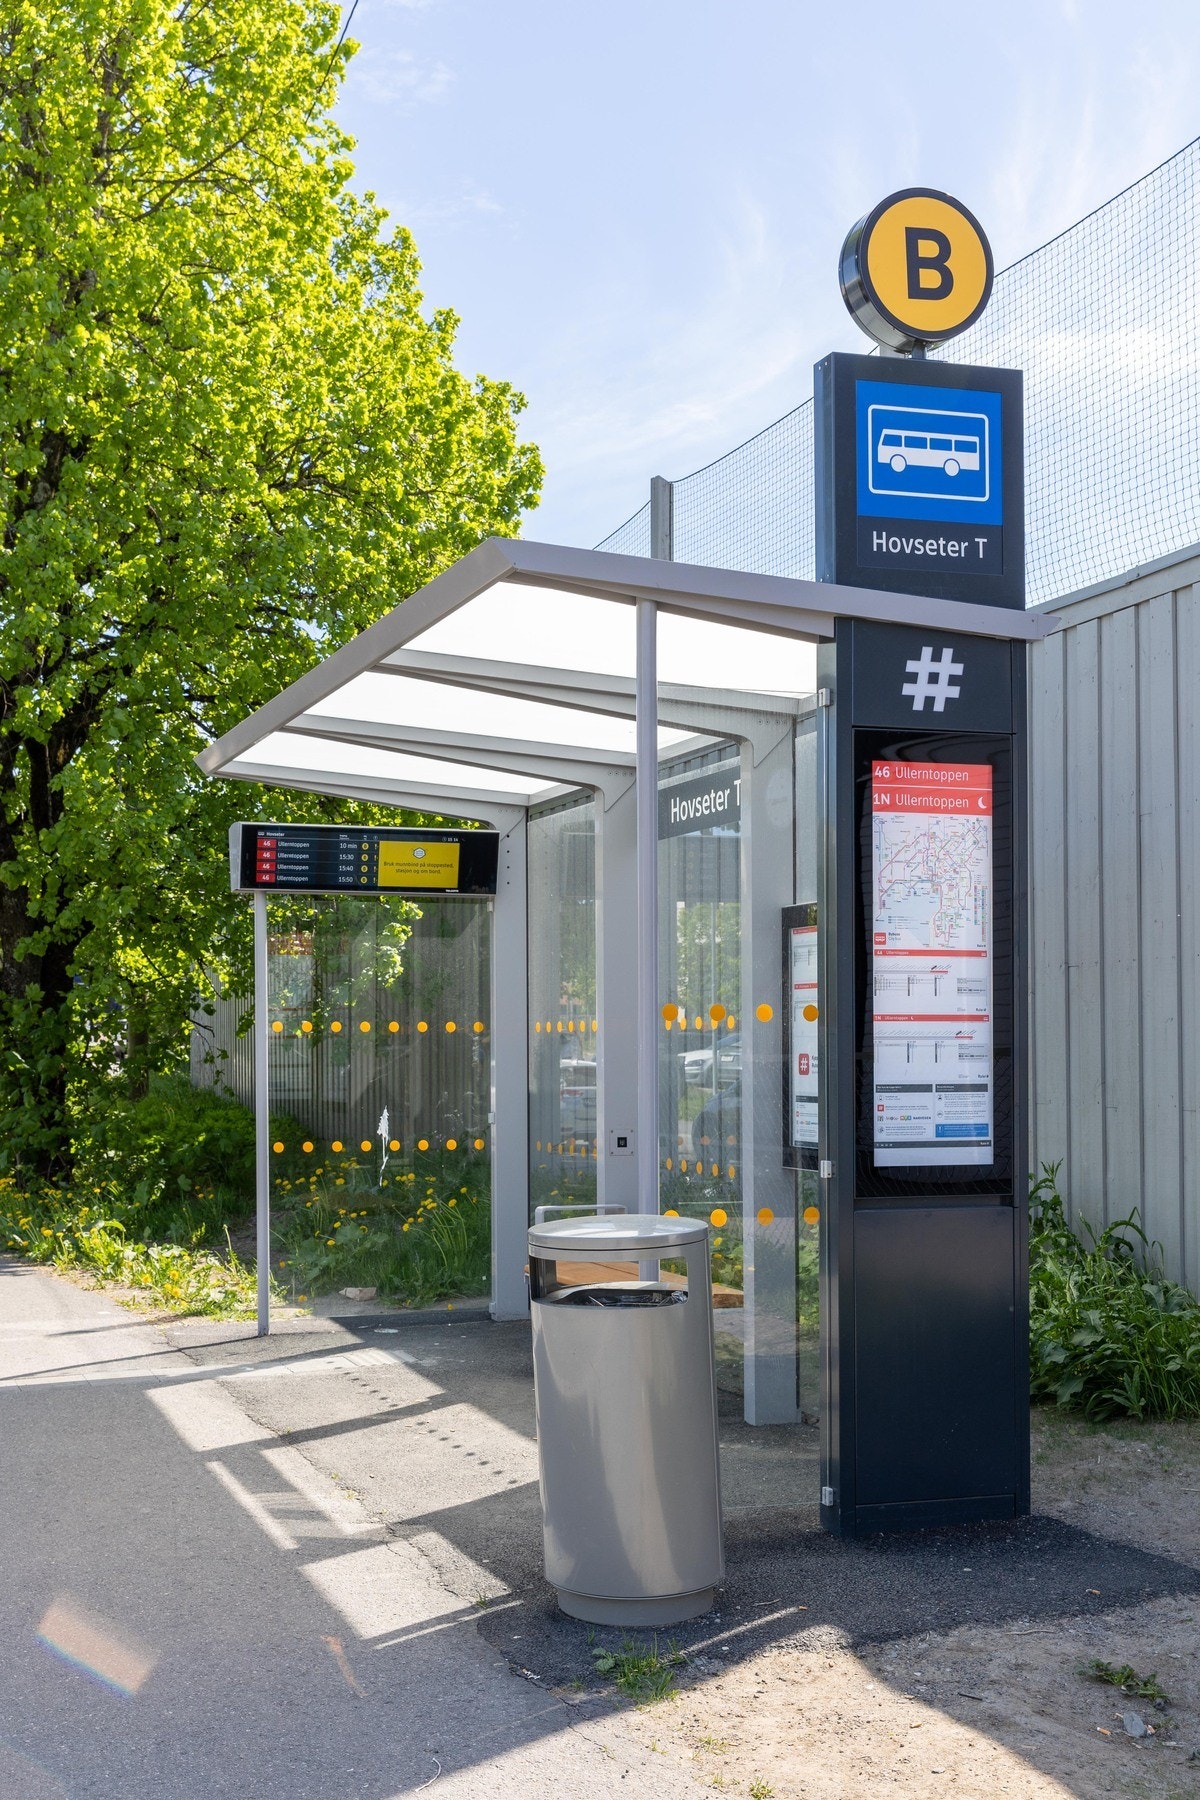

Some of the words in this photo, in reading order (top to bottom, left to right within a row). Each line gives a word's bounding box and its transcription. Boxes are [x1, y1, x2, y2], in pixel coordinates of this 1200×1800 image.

[905, 226, 954, 301] B
[872, 530, 969, 557] Hovseter
[974, 538, 988, 558] T
[874, 766, 890, 778] 46
[895, 766, 969, 783] Ullerntoppen
[671, 788, 730, 823] Hovseter
[733, 779, 741, 806] T
[873, 793, 890, 805] 1N
[895, 794, 969, 809] Ullerntoppen
